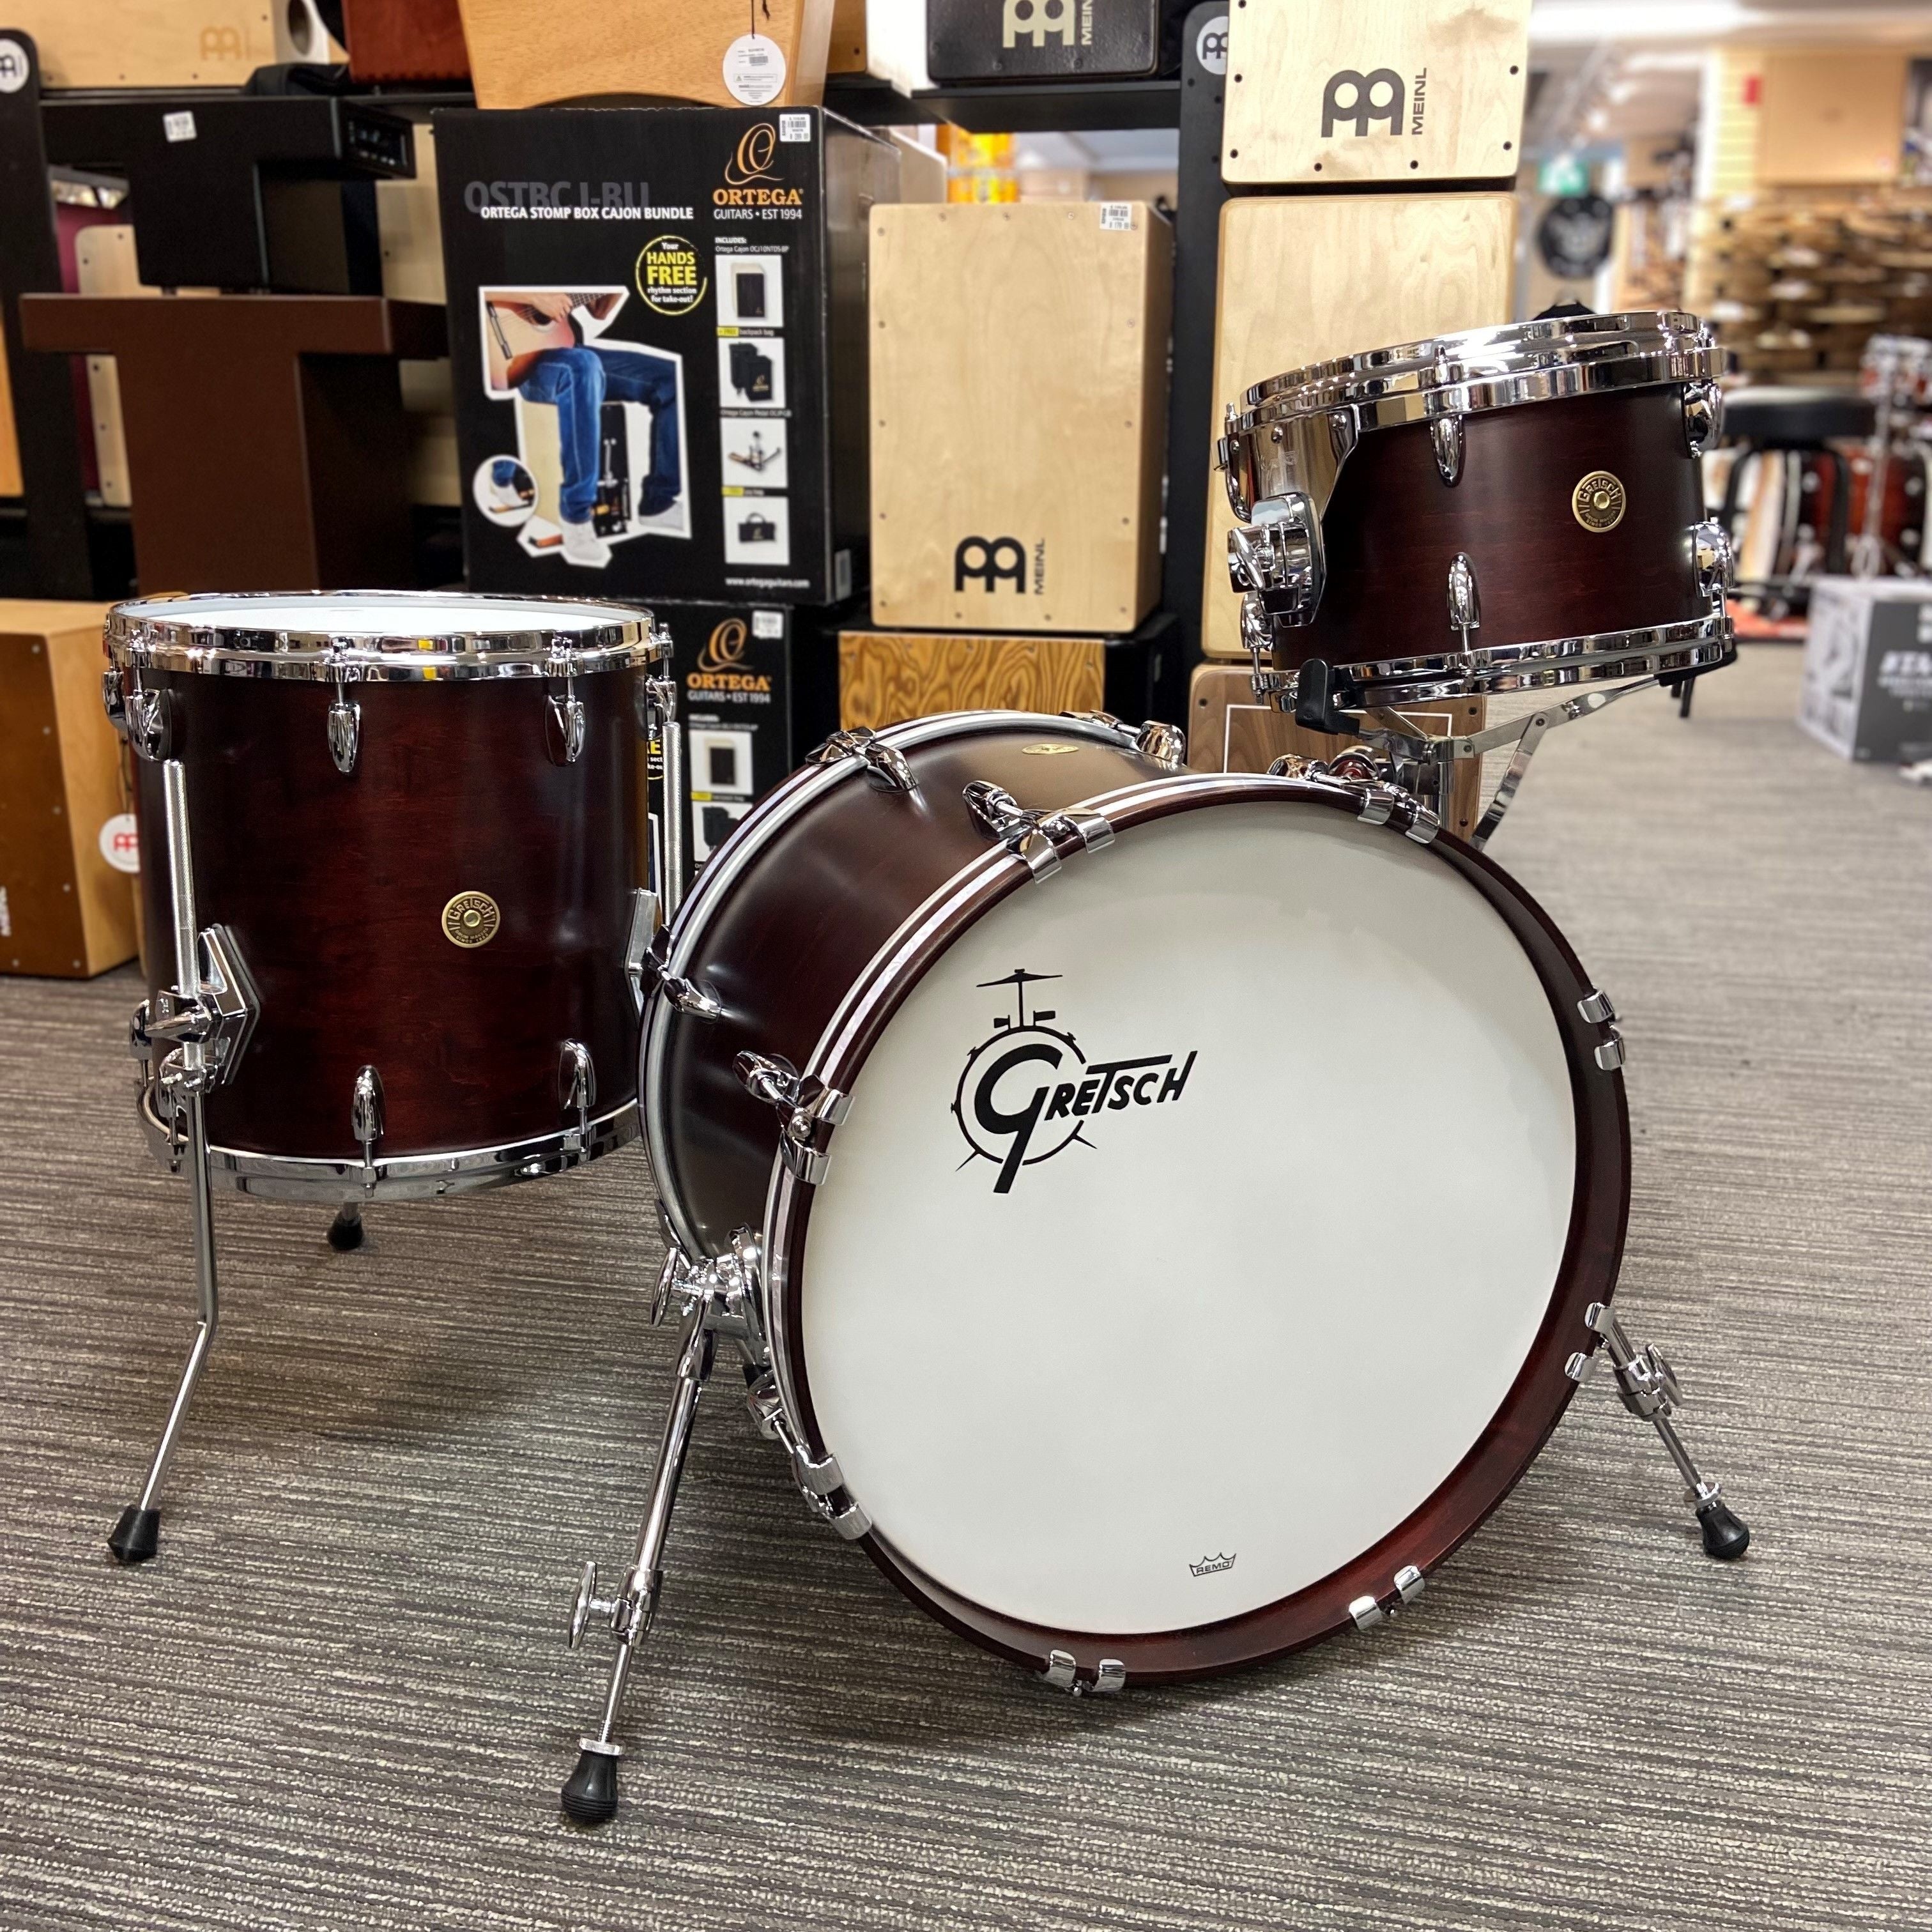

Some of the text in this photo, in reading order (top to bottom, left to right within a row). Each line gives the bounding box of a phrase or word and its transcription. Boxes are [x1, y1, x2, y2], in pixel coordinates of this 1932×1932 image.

[1081, 0, 1092, 45] MEIN
[1411, 68, 1427, 135] MEINL
[713, 188, 802, 206] ORTEGA
[481, 206, 694, 220] ORTEGA STOMP BOX CAJON BUNDLE
[714, 209, 802, 220] GUITARS EST 1994
[647, 252, 696, 264] HANDS
[647, 266, 697, 285] FREE
[647, 286, 671, 295] rhythm
[663, 295, 693, 303] take-out!
[1577, 476, 1622, 503] GRETSCH
[1034, 538, 1045, 595] MEINL
[687, 673, 770, 691] ORTEGA
[687, 690, 771, 703] GUITARS EST 1994
[448, 896, 496, 921] GRETSCH
[974, 1043, 1198, 1193] GRETSCH
[1196, 1561, 1230, 1574] REMO
